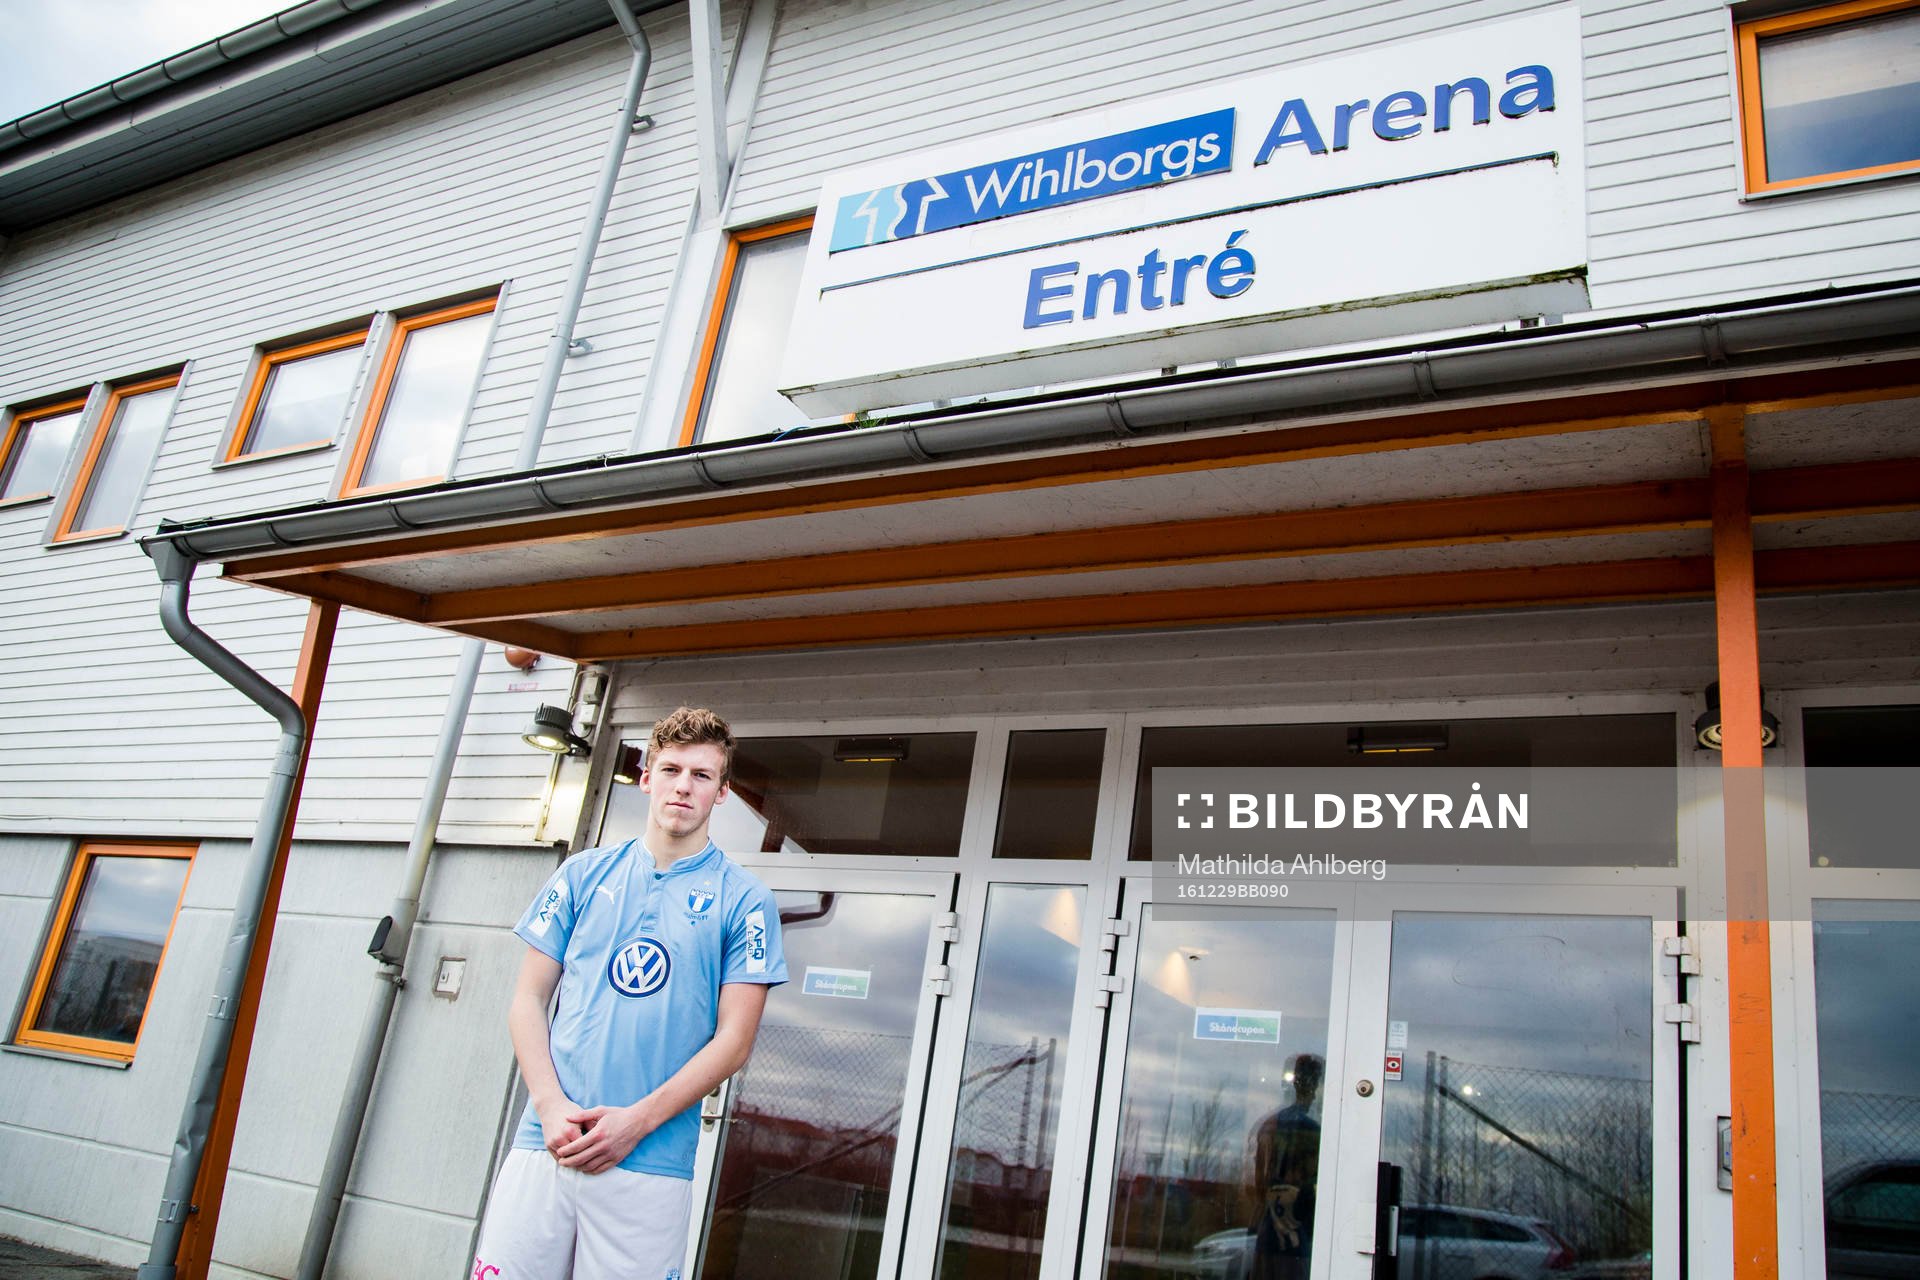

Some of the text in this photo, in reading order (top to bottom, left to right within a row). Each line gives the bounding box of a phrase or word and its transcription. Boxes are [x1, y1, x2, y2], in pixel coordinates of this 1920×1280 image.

[965, 64, 1556, 215] Wihlborgs Arena
[1023, 229, 1257, 330] Entré
